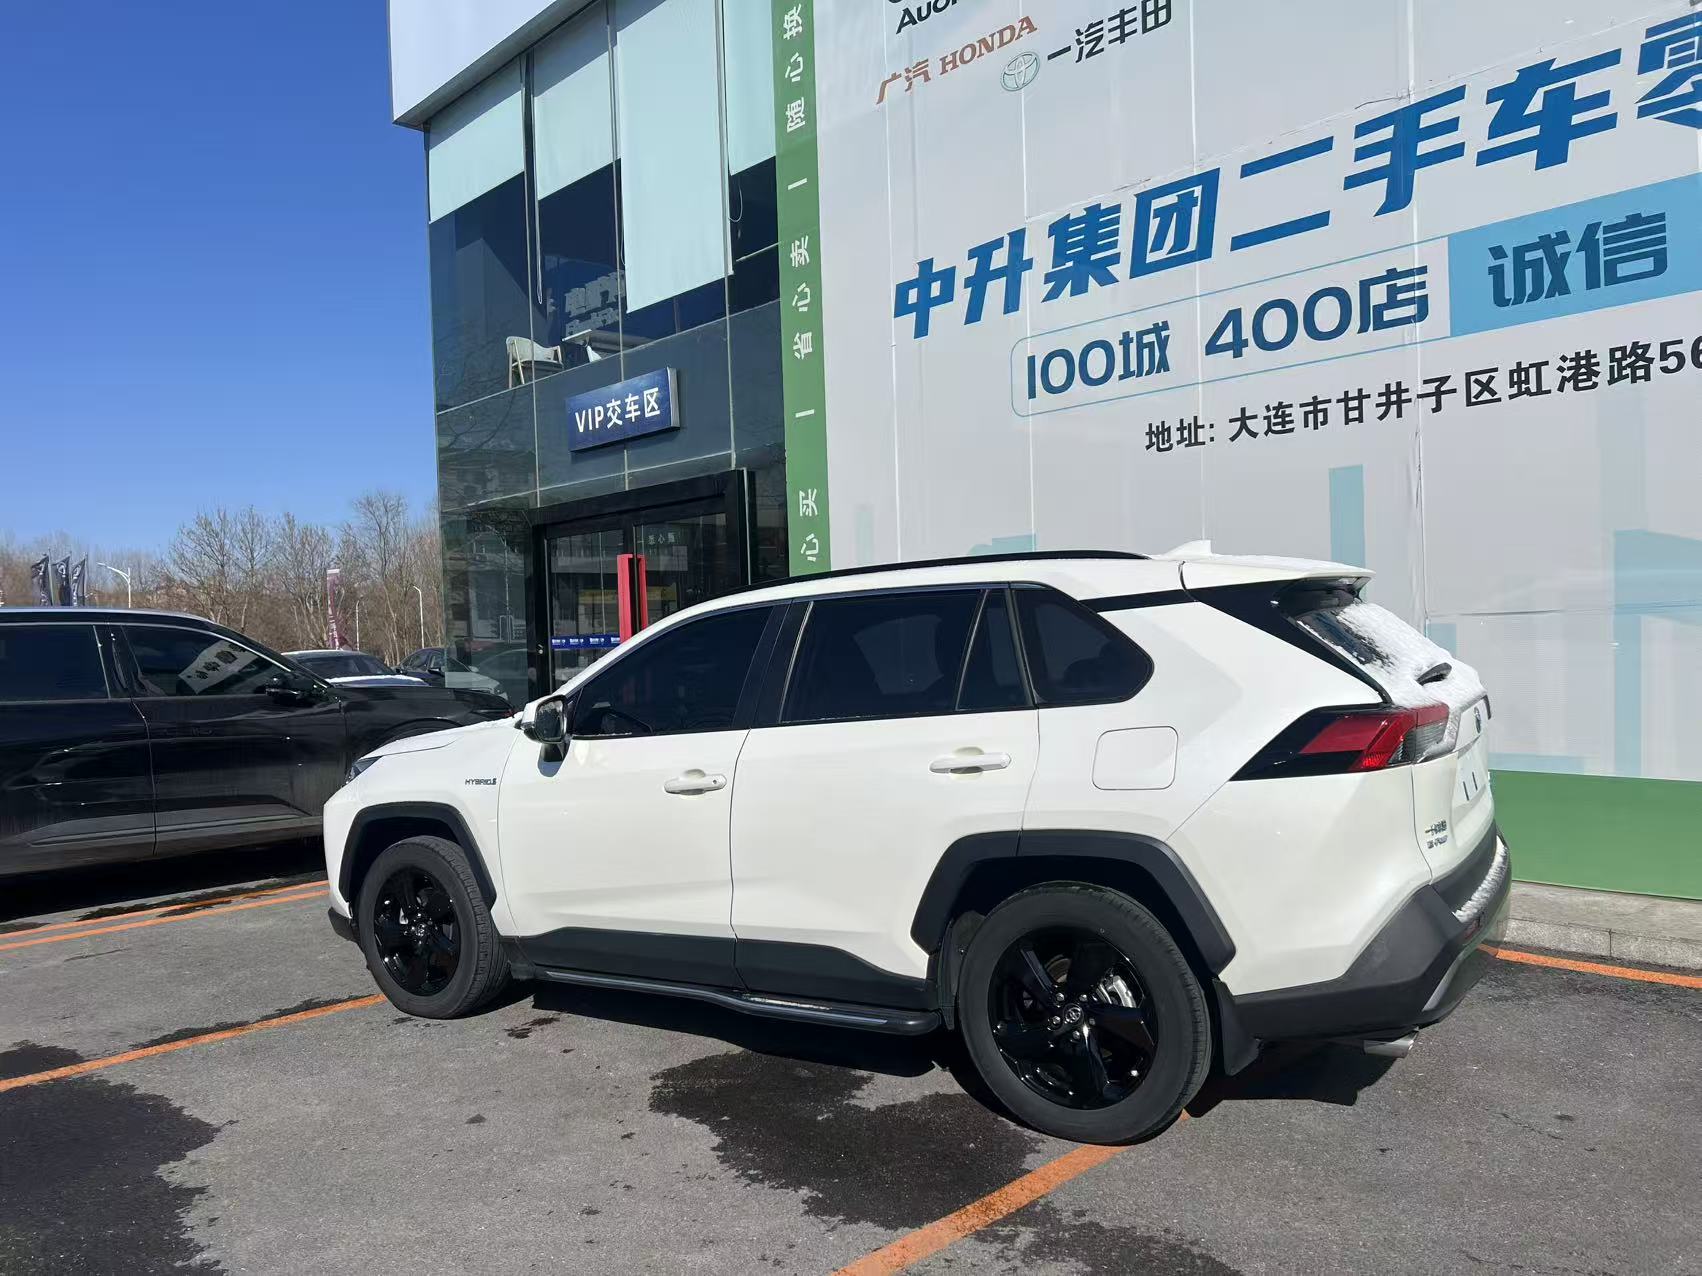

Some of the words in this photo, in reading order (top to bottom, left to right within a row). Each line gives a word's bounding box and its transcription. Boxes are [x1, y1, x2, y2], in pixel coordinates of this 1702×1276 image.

[896, 0, 958, 34] Au
[1048, 0, 1172, 63] 一汽丰田
[876, 59, 931, 105] 广汽
[940, 15, 1038, 75] HONDA
[1487, 211, 1668, 308] 诚信
[1027, 320, 1171, 400] 100城
[1205, 264, 1429, 359] 400店
[575, 387, 661, 433] VIP交车区
